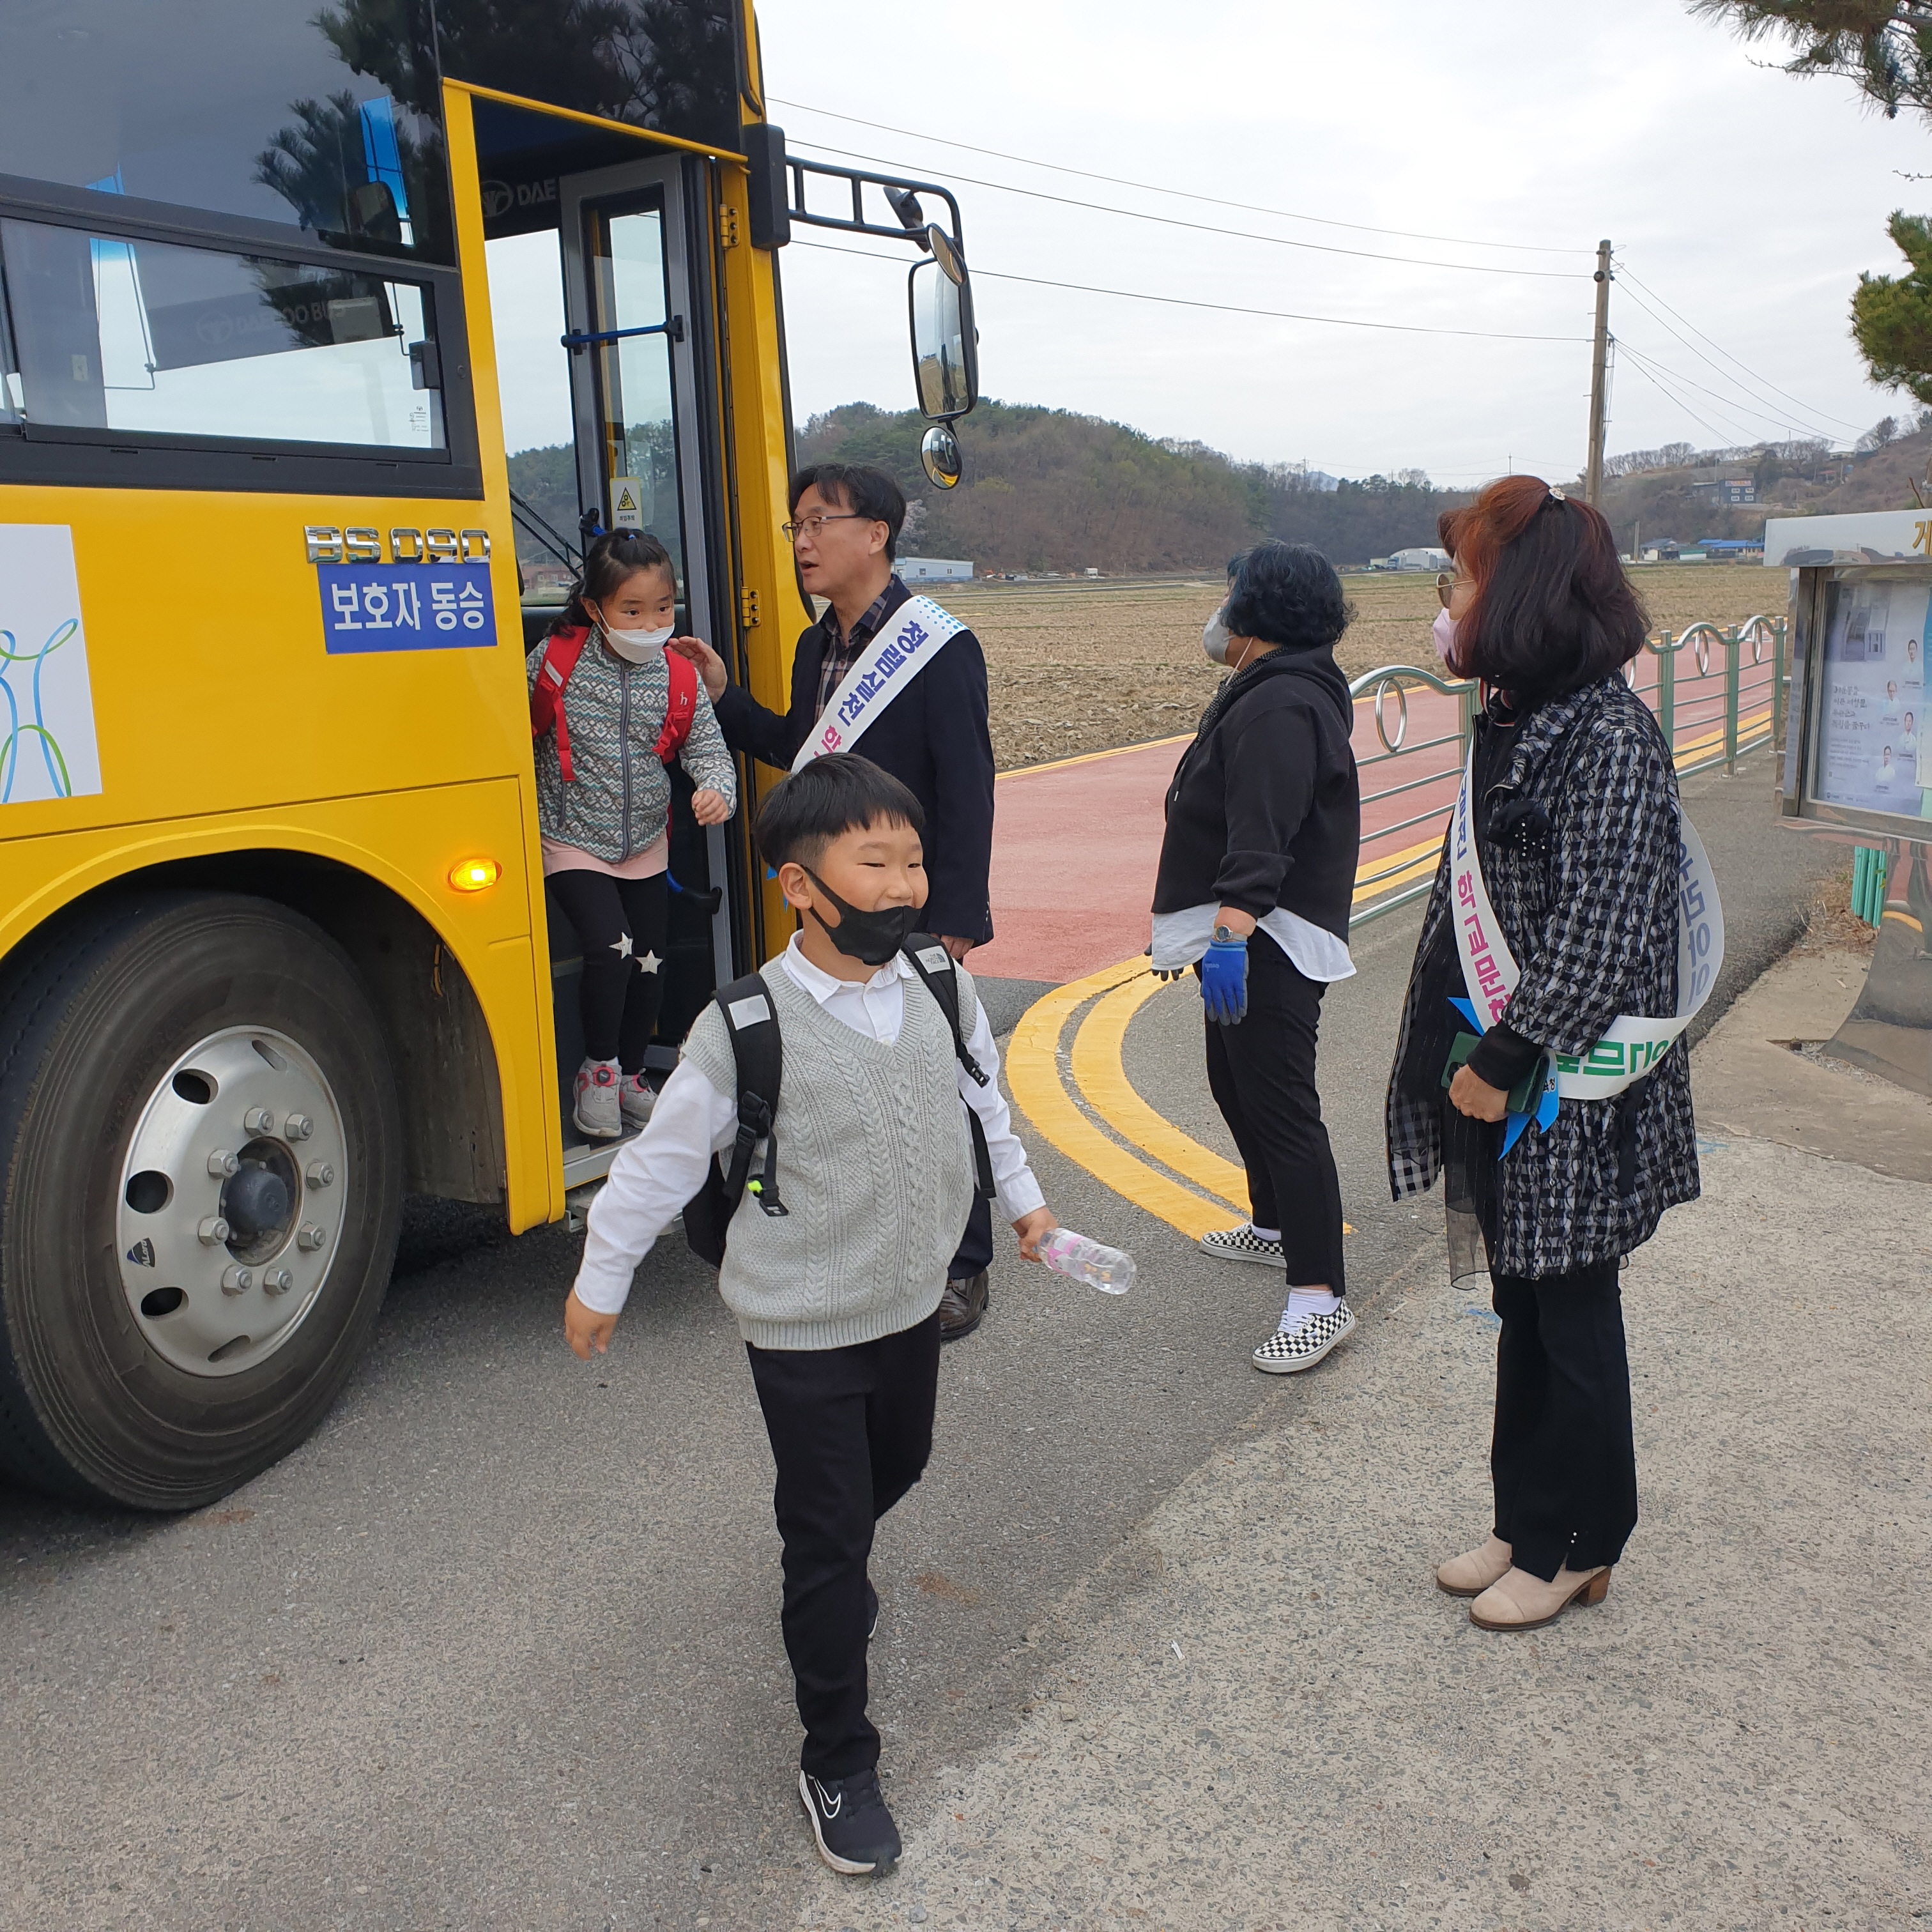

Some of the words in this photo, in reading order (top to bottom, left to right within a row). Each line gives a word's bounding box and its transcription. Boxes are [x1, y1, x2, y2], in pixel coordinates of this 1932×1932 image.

[304, 525, 382, 564] BS
[390, 527, 491, 564] 090
[332, 582, 421, 631] 보호자
[431, 581, 484, 631] 동승
[837, 620, 930, 727] 청렴실천
